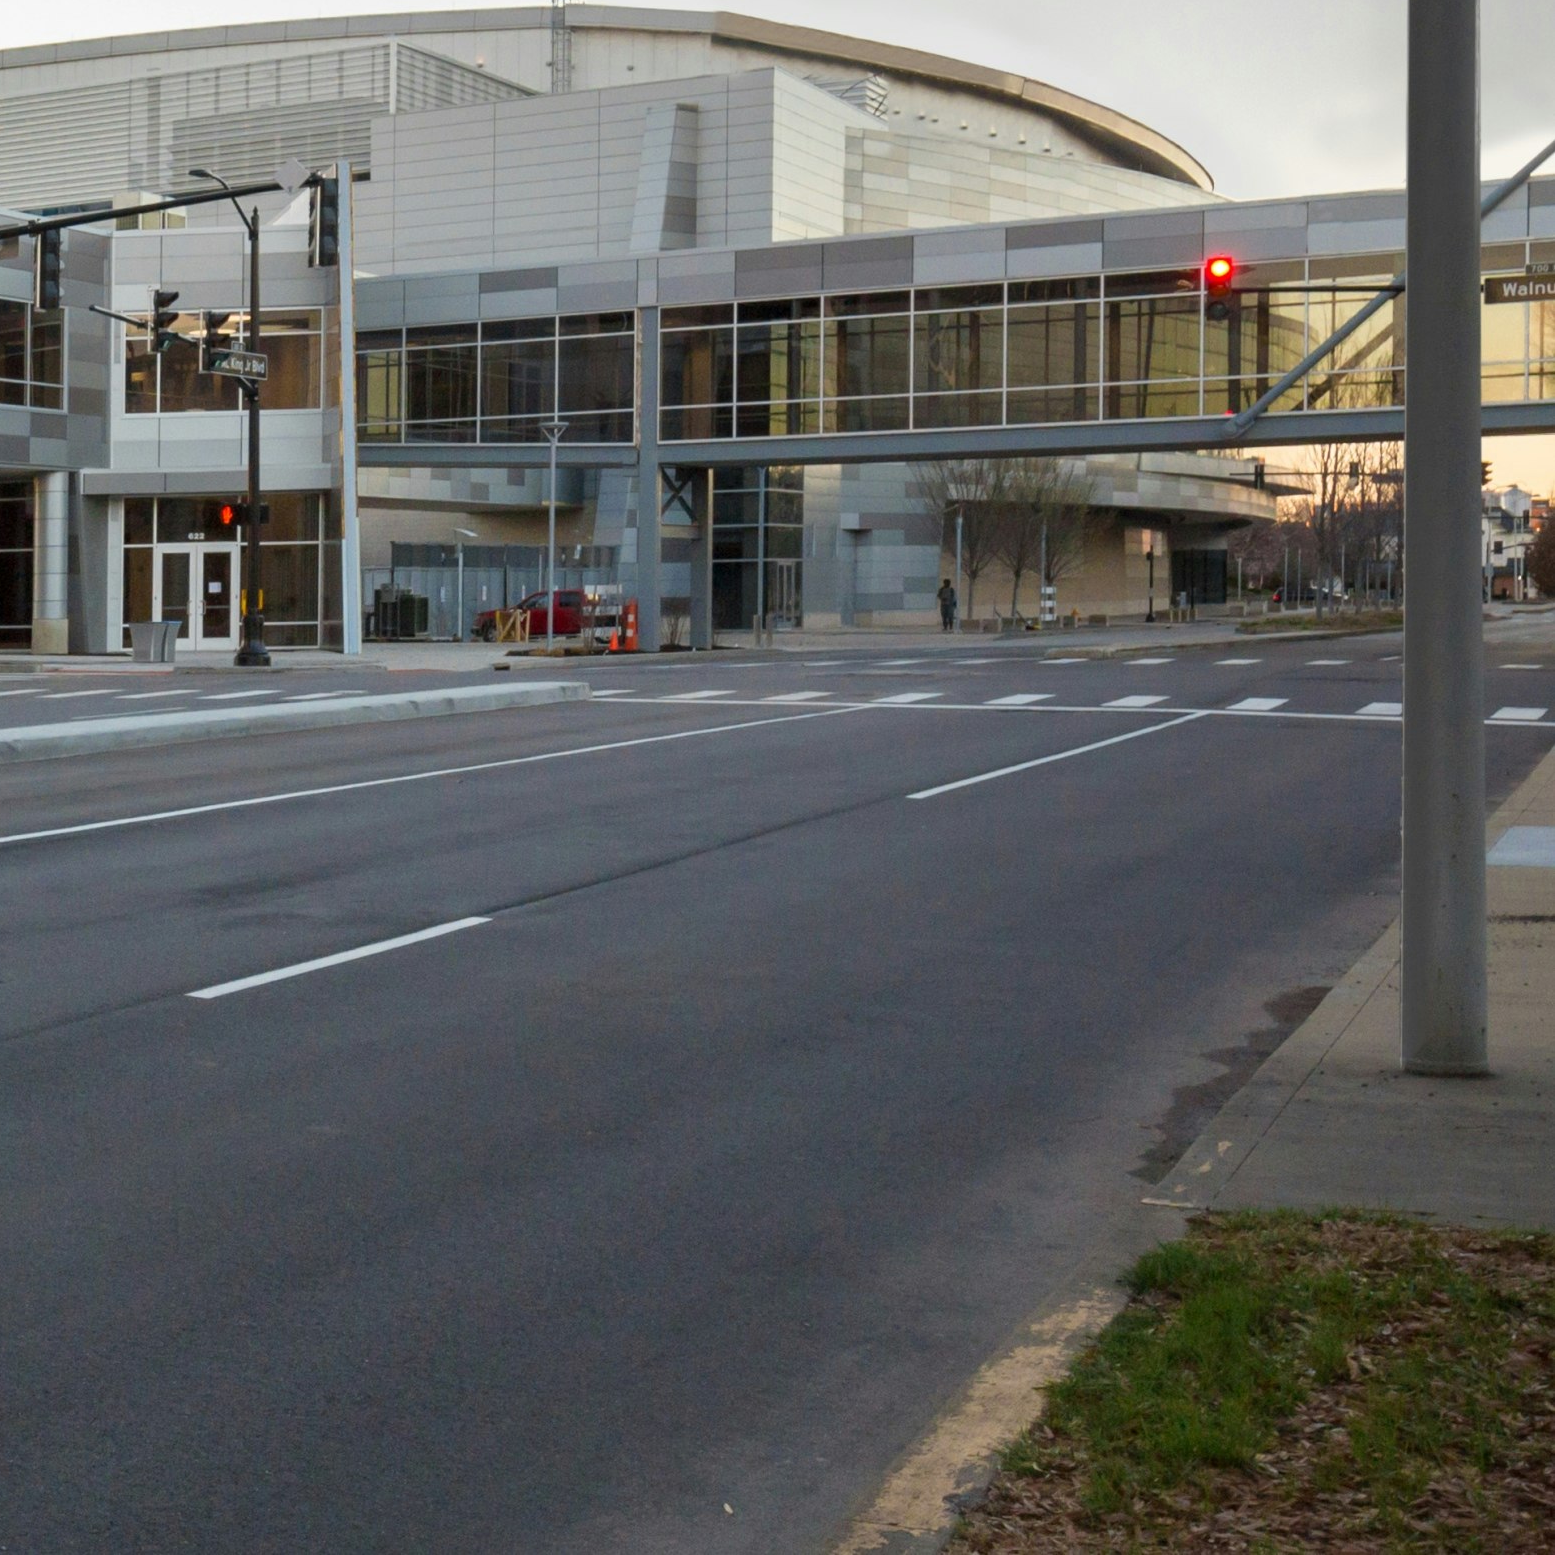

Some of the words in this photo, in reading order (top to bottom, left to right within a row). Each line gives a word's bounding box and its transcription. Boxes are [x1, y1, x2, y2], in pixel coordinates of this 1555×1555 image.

[1531, 264, 1549, 273] 700
[231, 356, 244, 374] King
[252, 359, 266, 374] Blvd
